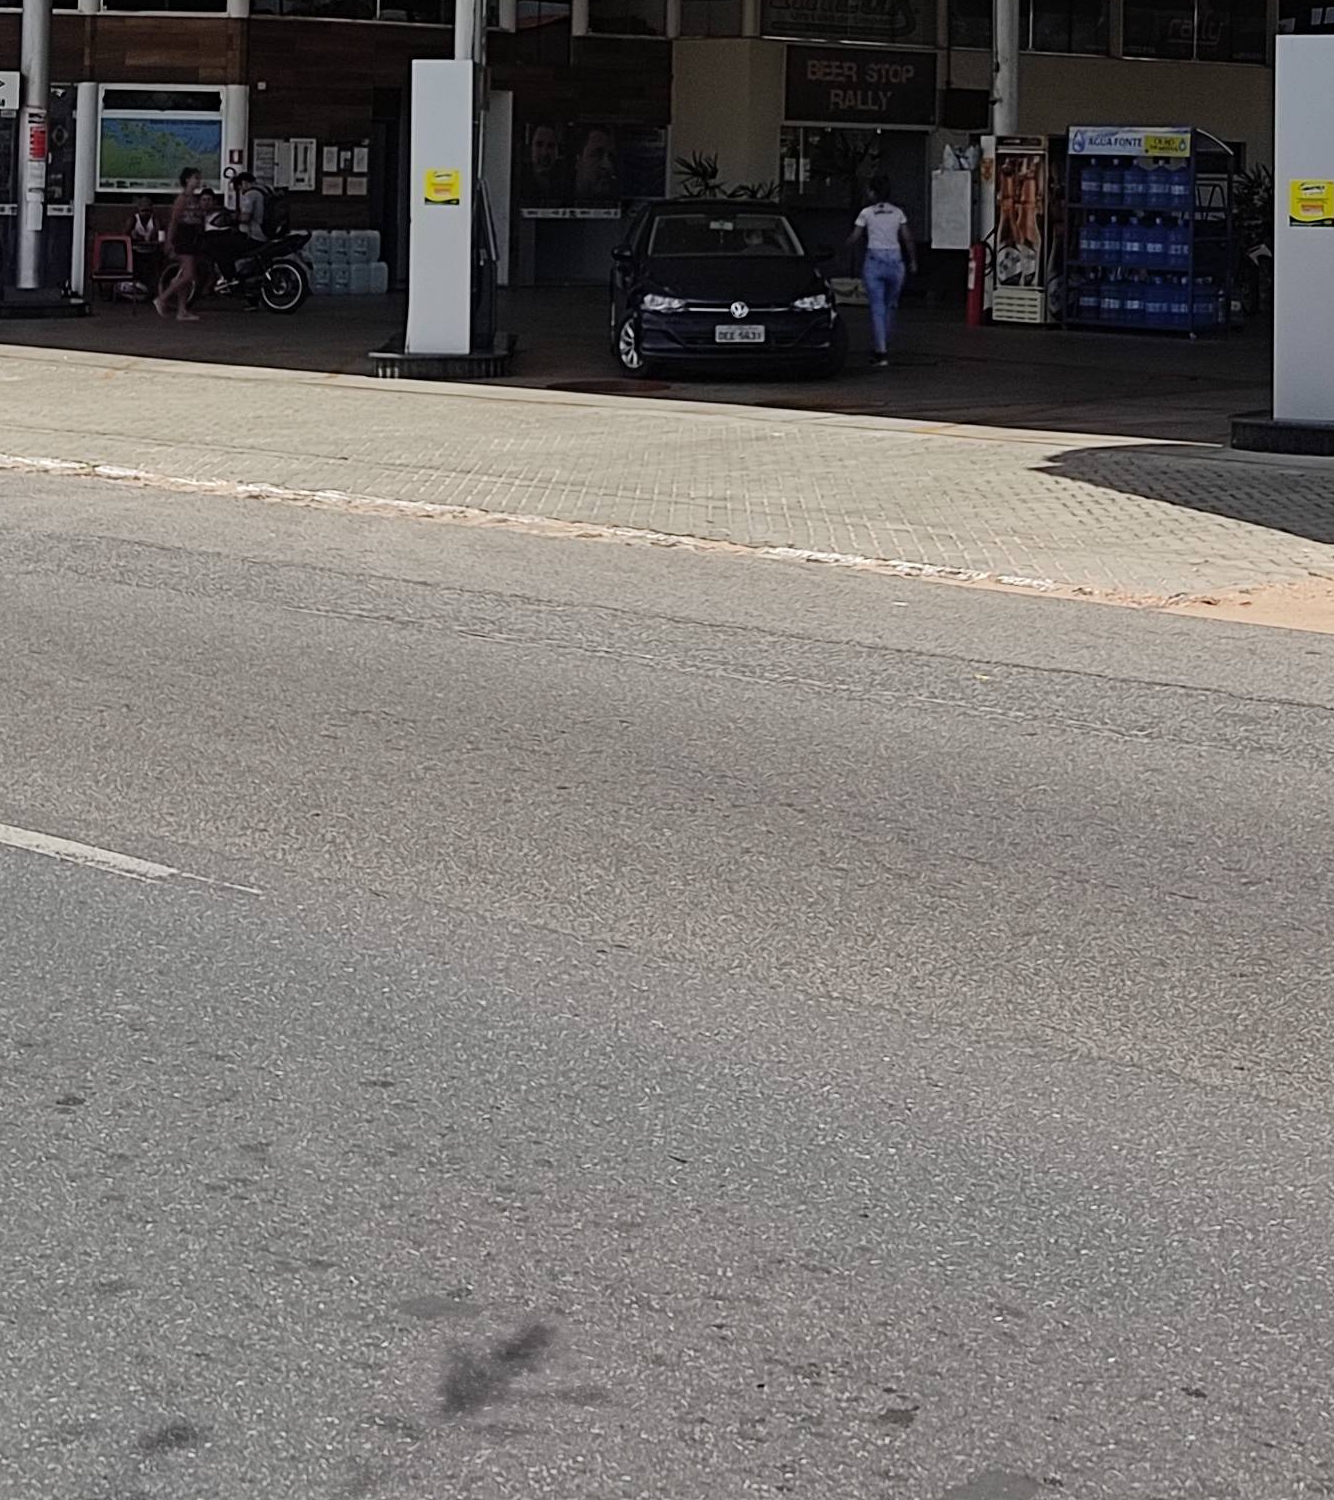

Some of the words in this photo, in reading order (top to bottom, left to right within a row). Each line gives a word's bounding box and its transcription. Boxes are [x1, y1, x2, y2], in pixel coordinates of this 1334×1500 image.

[806, 59, 857, 83] BEER
[864, 63, 915, 84] STOP
[829, 89, 893, 112] RALLY
